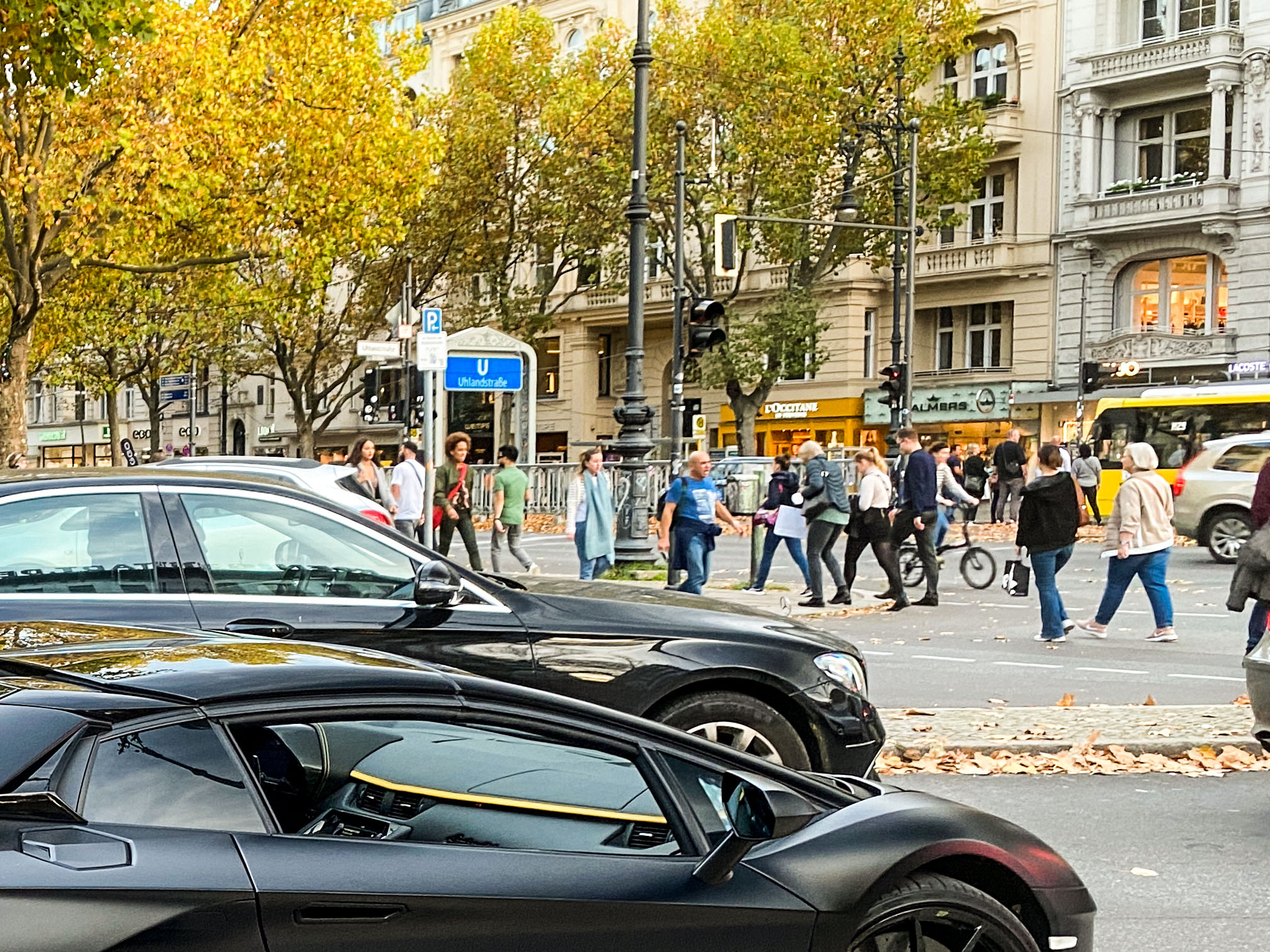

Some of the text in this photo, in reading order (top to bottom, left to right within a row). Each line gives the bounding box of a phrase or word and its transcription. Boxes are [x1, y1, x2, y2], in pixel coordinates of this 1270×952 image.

[477, 359, 489, 376] U
[1229, 362, 1268, 374] LACOSTE
[458, 377, 508, 388] Uhlandstraße
[764, 402, 819, 414] L'OCCITANE
